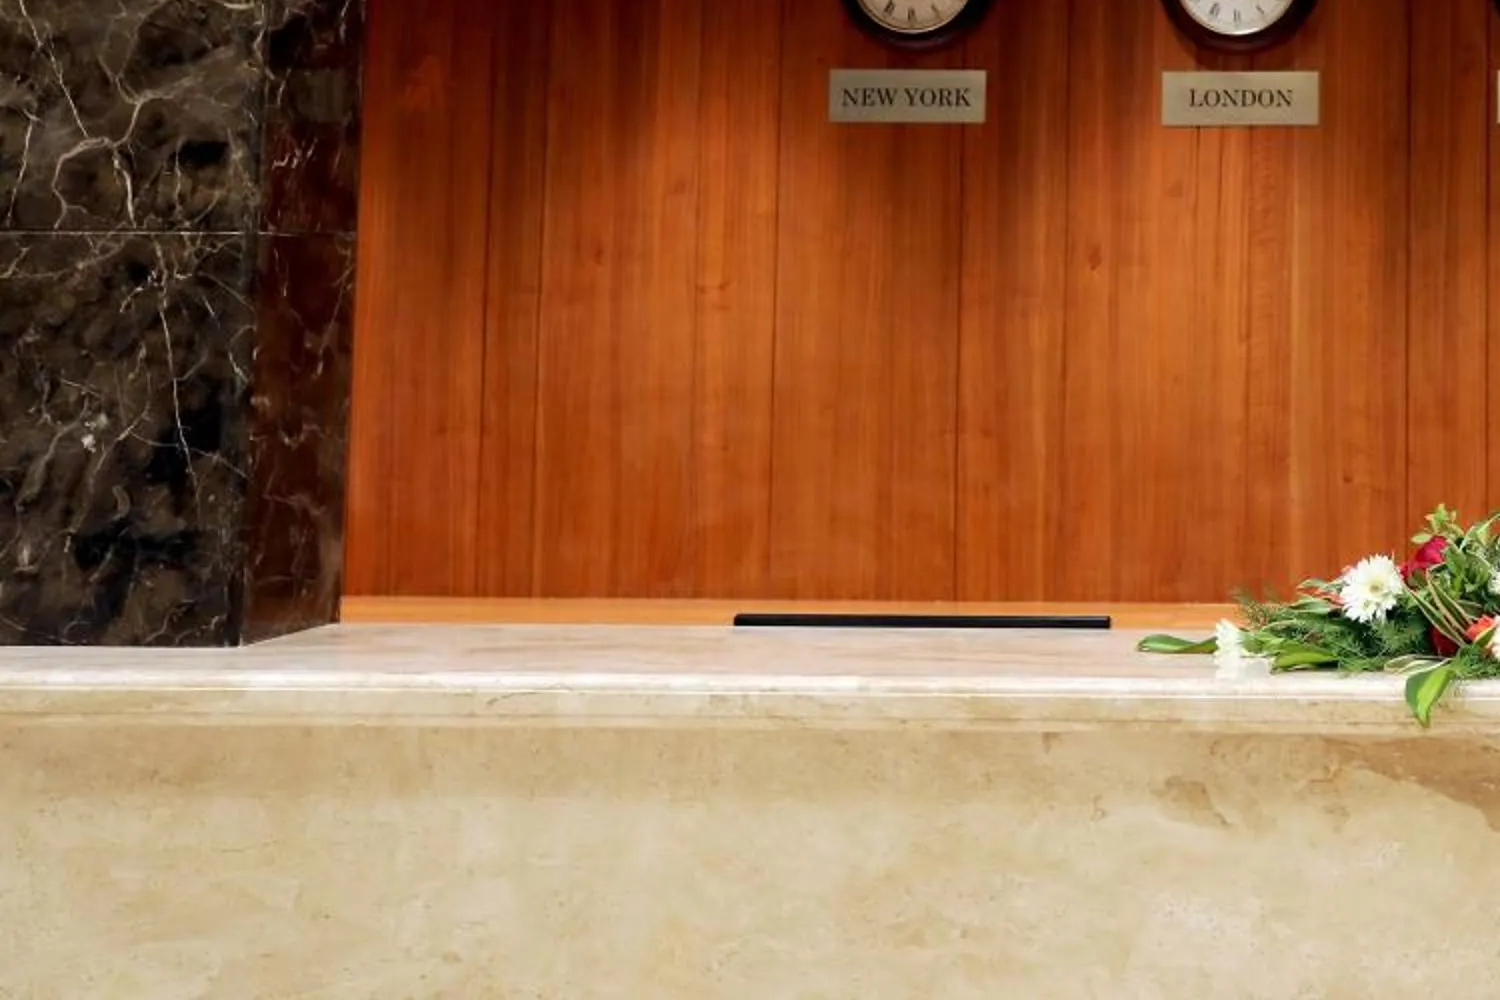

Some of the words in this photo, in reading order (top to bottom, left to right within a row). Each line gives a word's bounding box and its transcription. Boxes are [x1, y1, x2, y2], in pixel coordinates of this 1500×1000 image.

[840, 87, 899, 107] NEW
[903, 87, 972, 107] YORK
[1189, 88, 1294, 108] LONDON
